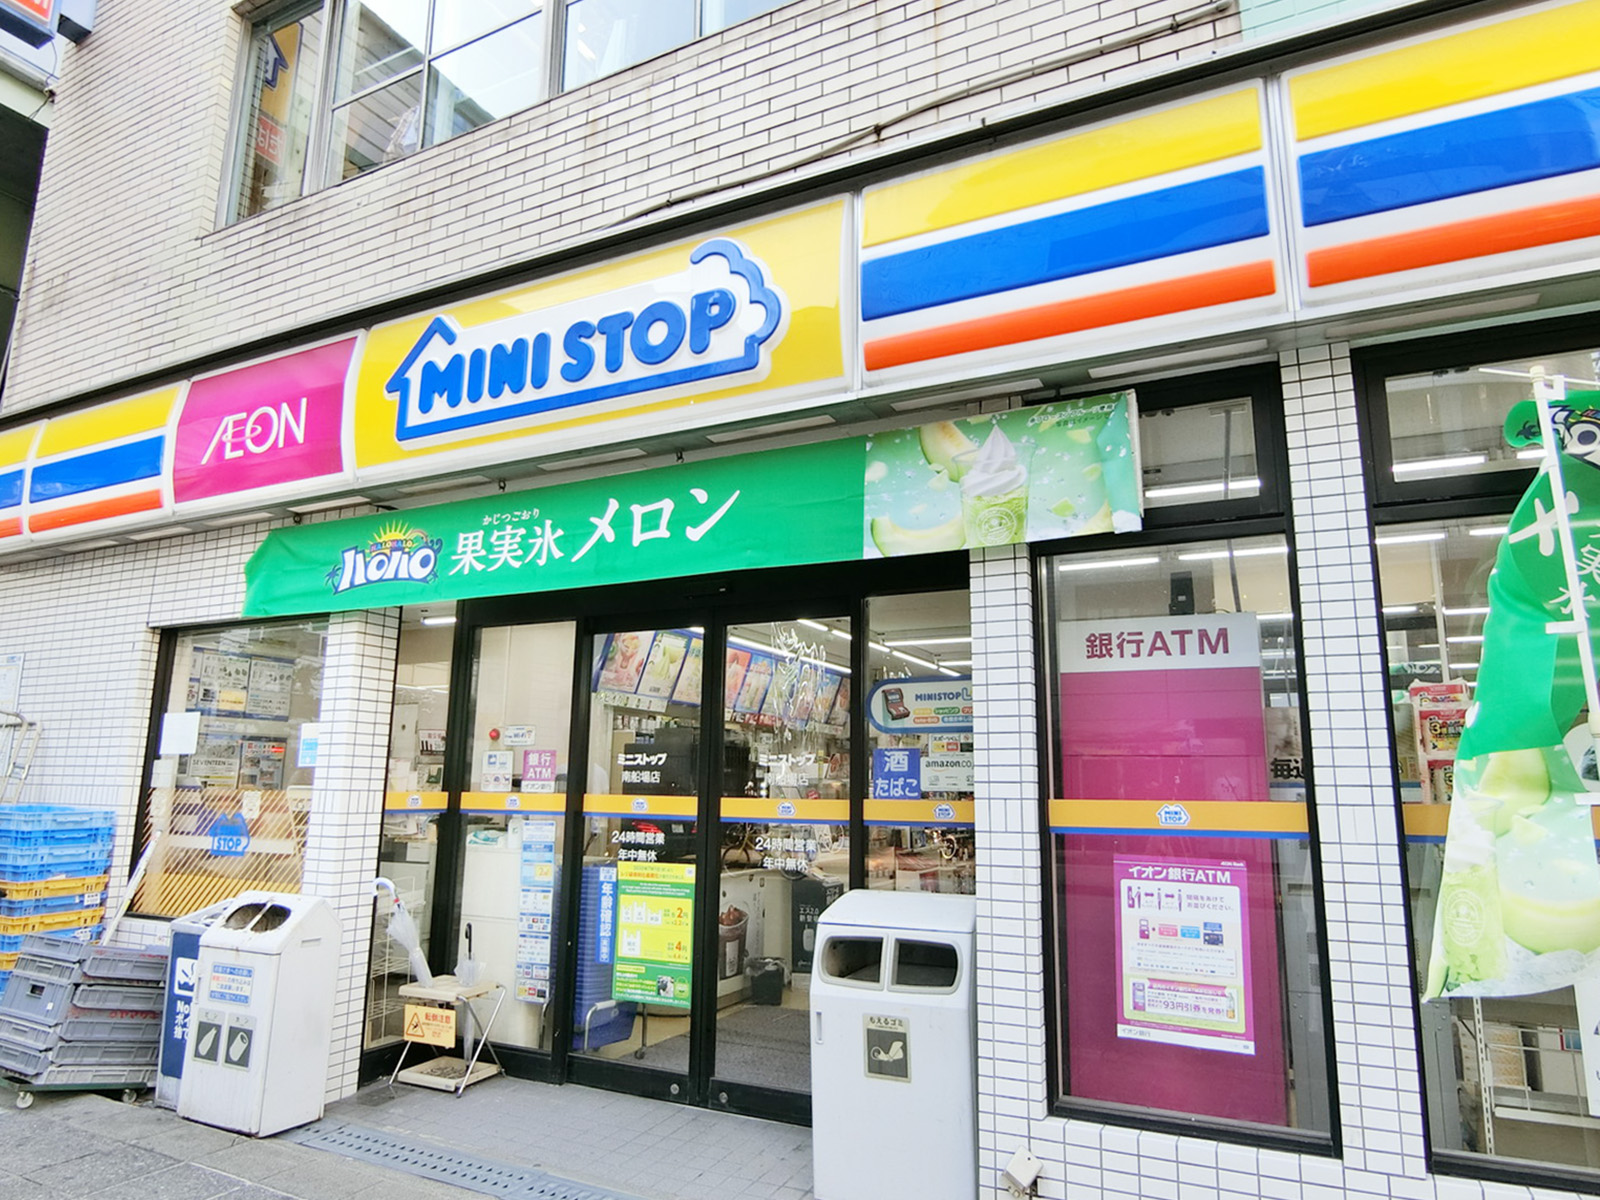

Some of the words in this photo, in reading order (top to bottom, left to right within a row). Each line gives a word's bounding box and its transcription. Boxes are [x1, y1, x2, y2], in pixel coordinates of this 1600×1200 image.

[418, 329, 553, 415] MINI
[559, 286, 738, 385] STOP
[482, 508, 540, 526] かじつごおり
[448, 519, 565, 579] 果実氷
[570, 487, 741, 565] メロン
[1085, 627, 1230, 660] 銀行ATM
[915, 692, 962, 702] MINISTOP
[617, 753, 668, 766] ミニストップ
[758, 752, 817, 767] ミニストップ
[884, 751, 909, 772] 酒
[527, 767, 552, 779] ATM
[875, 777, 919, 797] たばこ
[216, 837, 242, 851] STOP
[611, 830, 665, 845] 24時間営業
[755, 837, 817, 853] 24時間営業
[617, 848, 658, 863] 年中無休
[762, 856, 809, 872] 年中無休
[1128, 865, 1231, 884] イオン銀行ATM
[869, 1016, 903, 1027] もえるゴミ
